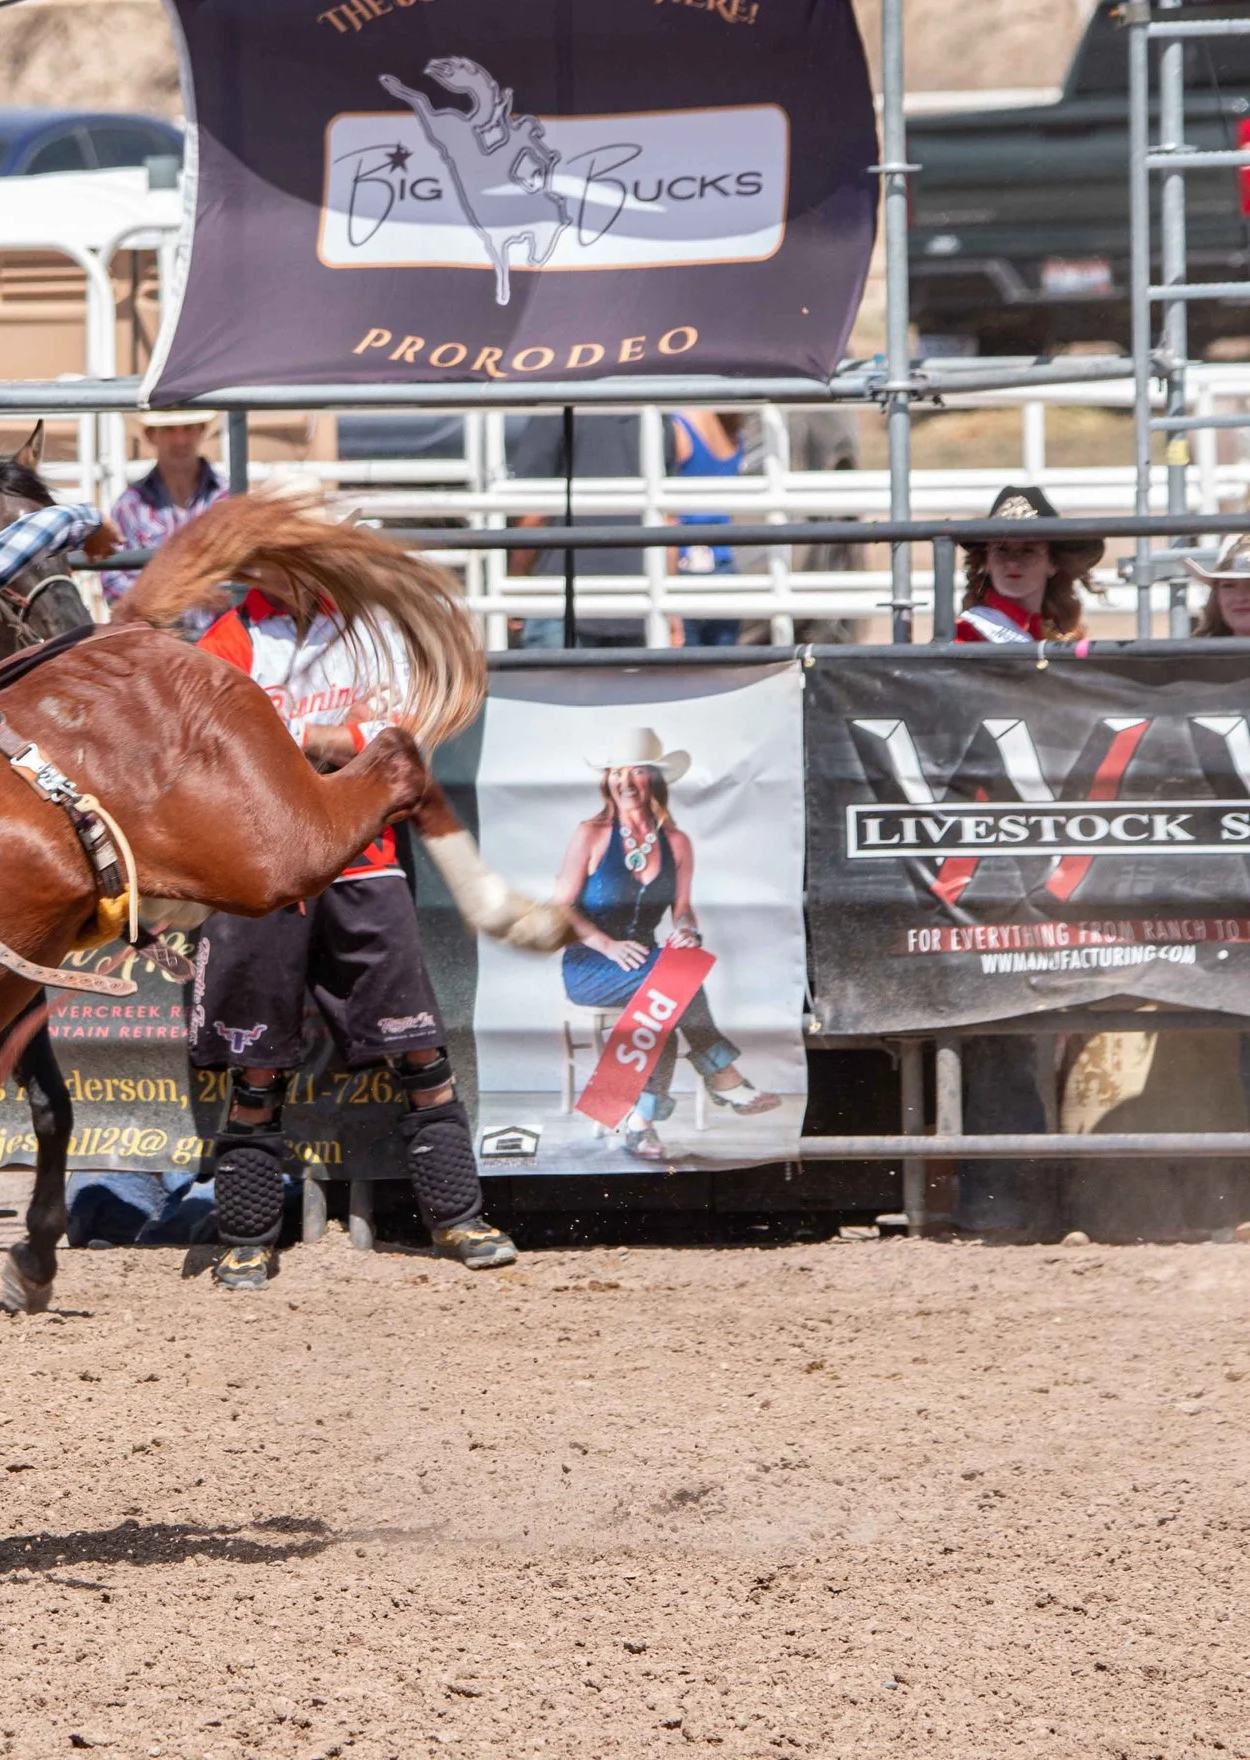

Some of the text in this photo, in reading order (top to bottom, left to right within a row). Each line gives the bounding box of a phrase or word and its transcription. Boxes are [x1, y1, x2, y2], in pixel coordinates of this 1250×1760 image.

[334, 140, 763, 247] BIG BUCKS
[352, 325, 700, 378] PRORODEO
[861, 813, 1197, 846] LIVESTOCK
[907, 918, 1240, 953] FOR EVERYTHING FROM RANCH TO
[980, 944, 1197, 975] WWMANUFACTURINGCOM
[49, 1005, 161, 1019] VERCREEK
[49, 1026, 190, 1039] NTAIN RETREA
[616, 989, 679, 1073] Sold
